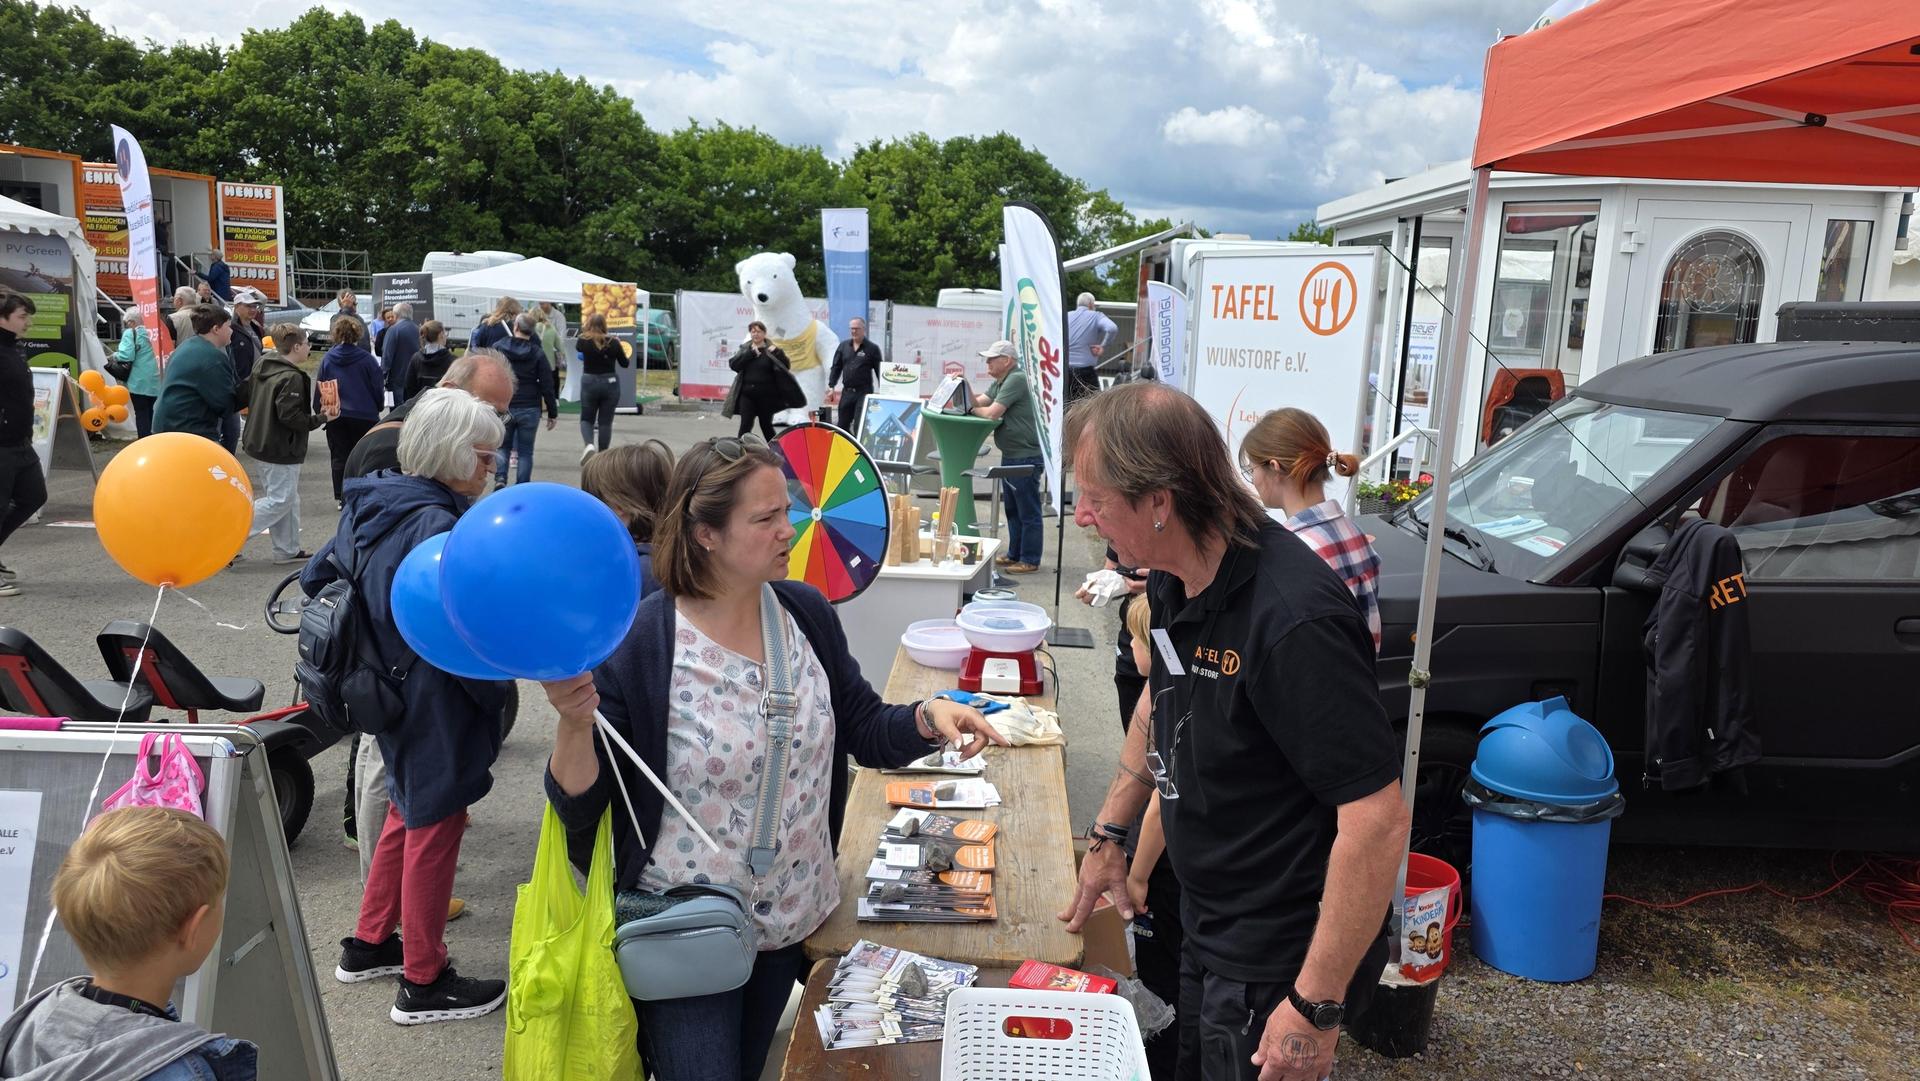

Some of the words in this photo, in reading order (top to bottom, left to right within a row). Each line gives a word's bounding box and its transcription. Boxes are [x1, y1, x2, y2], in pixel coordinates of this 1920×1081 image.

[83, 171, 120, 184] ENKE
[225, 185, 272, 199] HENKE
[87, 216, 126, 225] BAUKÜCHEN
[226, 226, 275, 236] EINBAUKÜCHEN
[245, 233, 267, 241] FABRIK
[6, 243, 22, 253] PV
[25, 244, 62, 256] Green
[1212, 285, 1279, 321] TAFEL
[1207, 346, 1281, 371] WUNSTORF
[1285, 351, 1310, 373] e.V.
